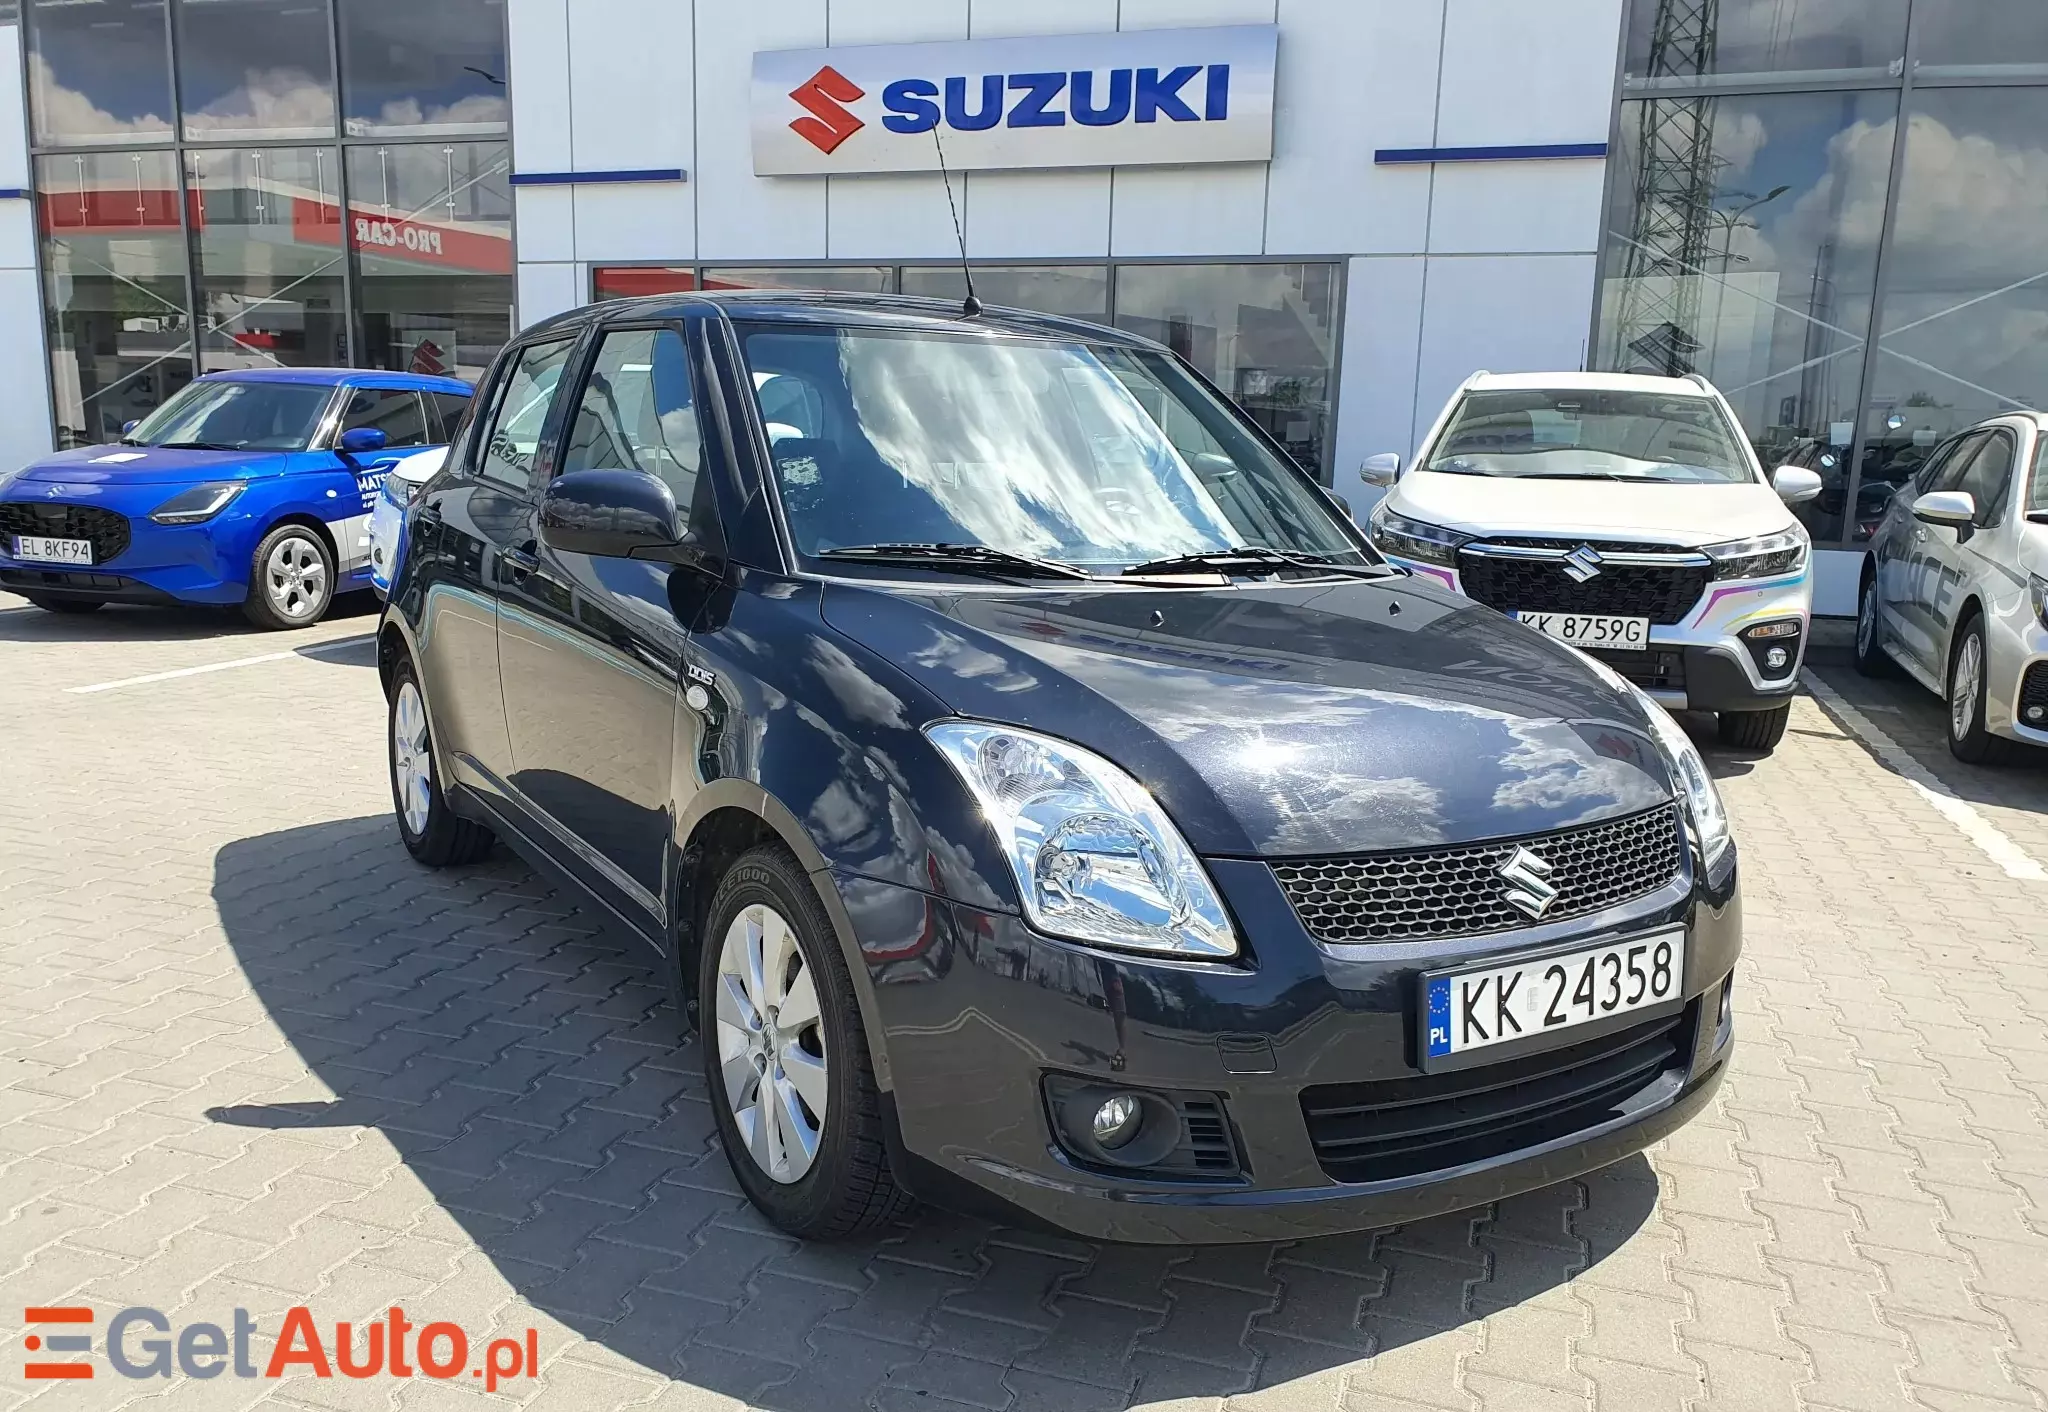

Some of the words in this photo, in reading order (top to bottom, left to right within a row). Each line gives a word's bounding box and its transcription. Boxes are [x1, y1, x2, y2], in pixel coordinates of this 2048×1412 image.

[882, 64, 1230, 134] SUZUKI
[357, 472, 391, 492] MATS
[21, 538, 39, 556] EL
[44, 540, 89, 560] 8KF94
[1562, 617, 1641, 642] 8759G
[1462, 971, 1523, 1044] KK
[1544, 941, 1672, 1026] 24358
[1430, 1026, 1448, 1046] PL
